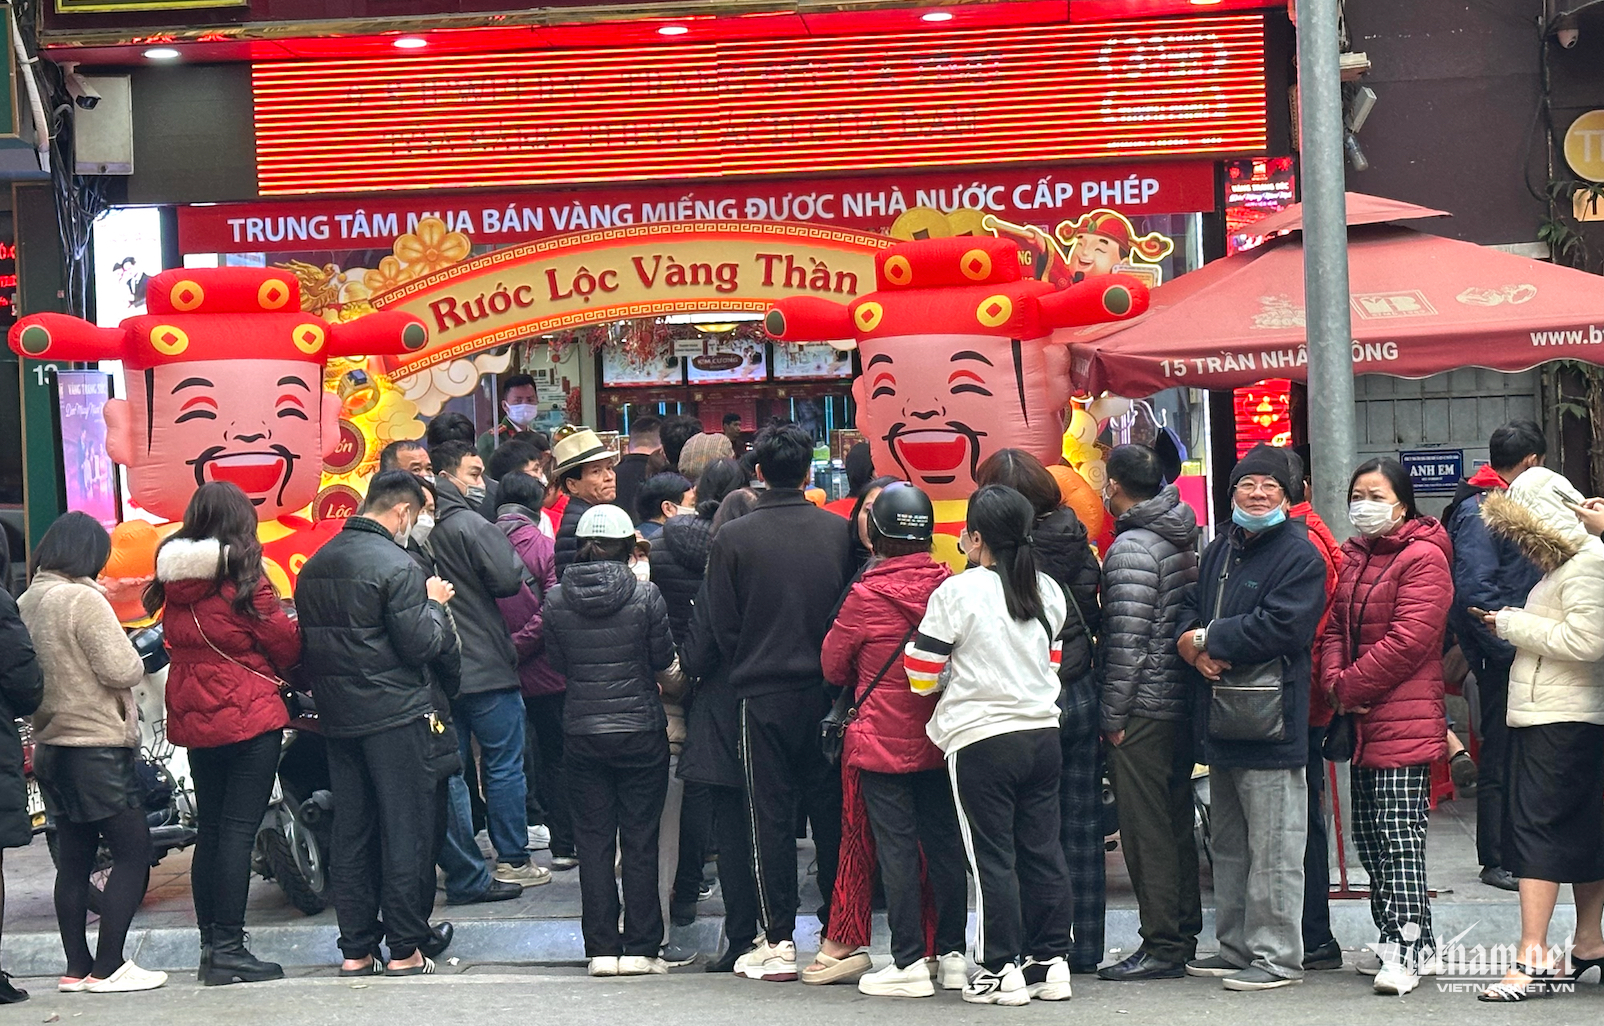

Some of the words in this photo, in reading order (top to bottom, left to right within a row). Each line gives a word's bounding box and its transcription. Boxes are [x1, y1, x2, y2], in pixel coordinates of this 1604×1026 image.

[227, 214, 330, 243] TRUNG
[334, 208, 398, 239] TÂM
[482, 203, 544, 234] BÁN
[550, 200, 634, 230] VÀNG
[641, 192, 738, 222] MIẾNG
[842, 186, 907, 218] NHÀ
[915, 180, 1006, 213] NƯỚC
[1012, 174, 1074, 210] CẤP
[1080, 173, 1160, 206] PHÉP
[1017, 250, 1032, 266] NG
[428, 281, 535, 334] Rước
[544, 265, 620, 303] Lộc
[630, 253, 740, 293] Vàng
[755, 252, 859, 296] Thần
[1529, 324, 1604, 347] www.b
[1159, 358, 1188, 378] 15
[1190, 350, 1256, 376] TRẦN
[1261, 343, 1308, 370] NHÂ
[1351, 339, 1399, 364] ÔNG
[1409, 463, 1435, 477] ANH
[1437, 463, 1455, 476] EM
